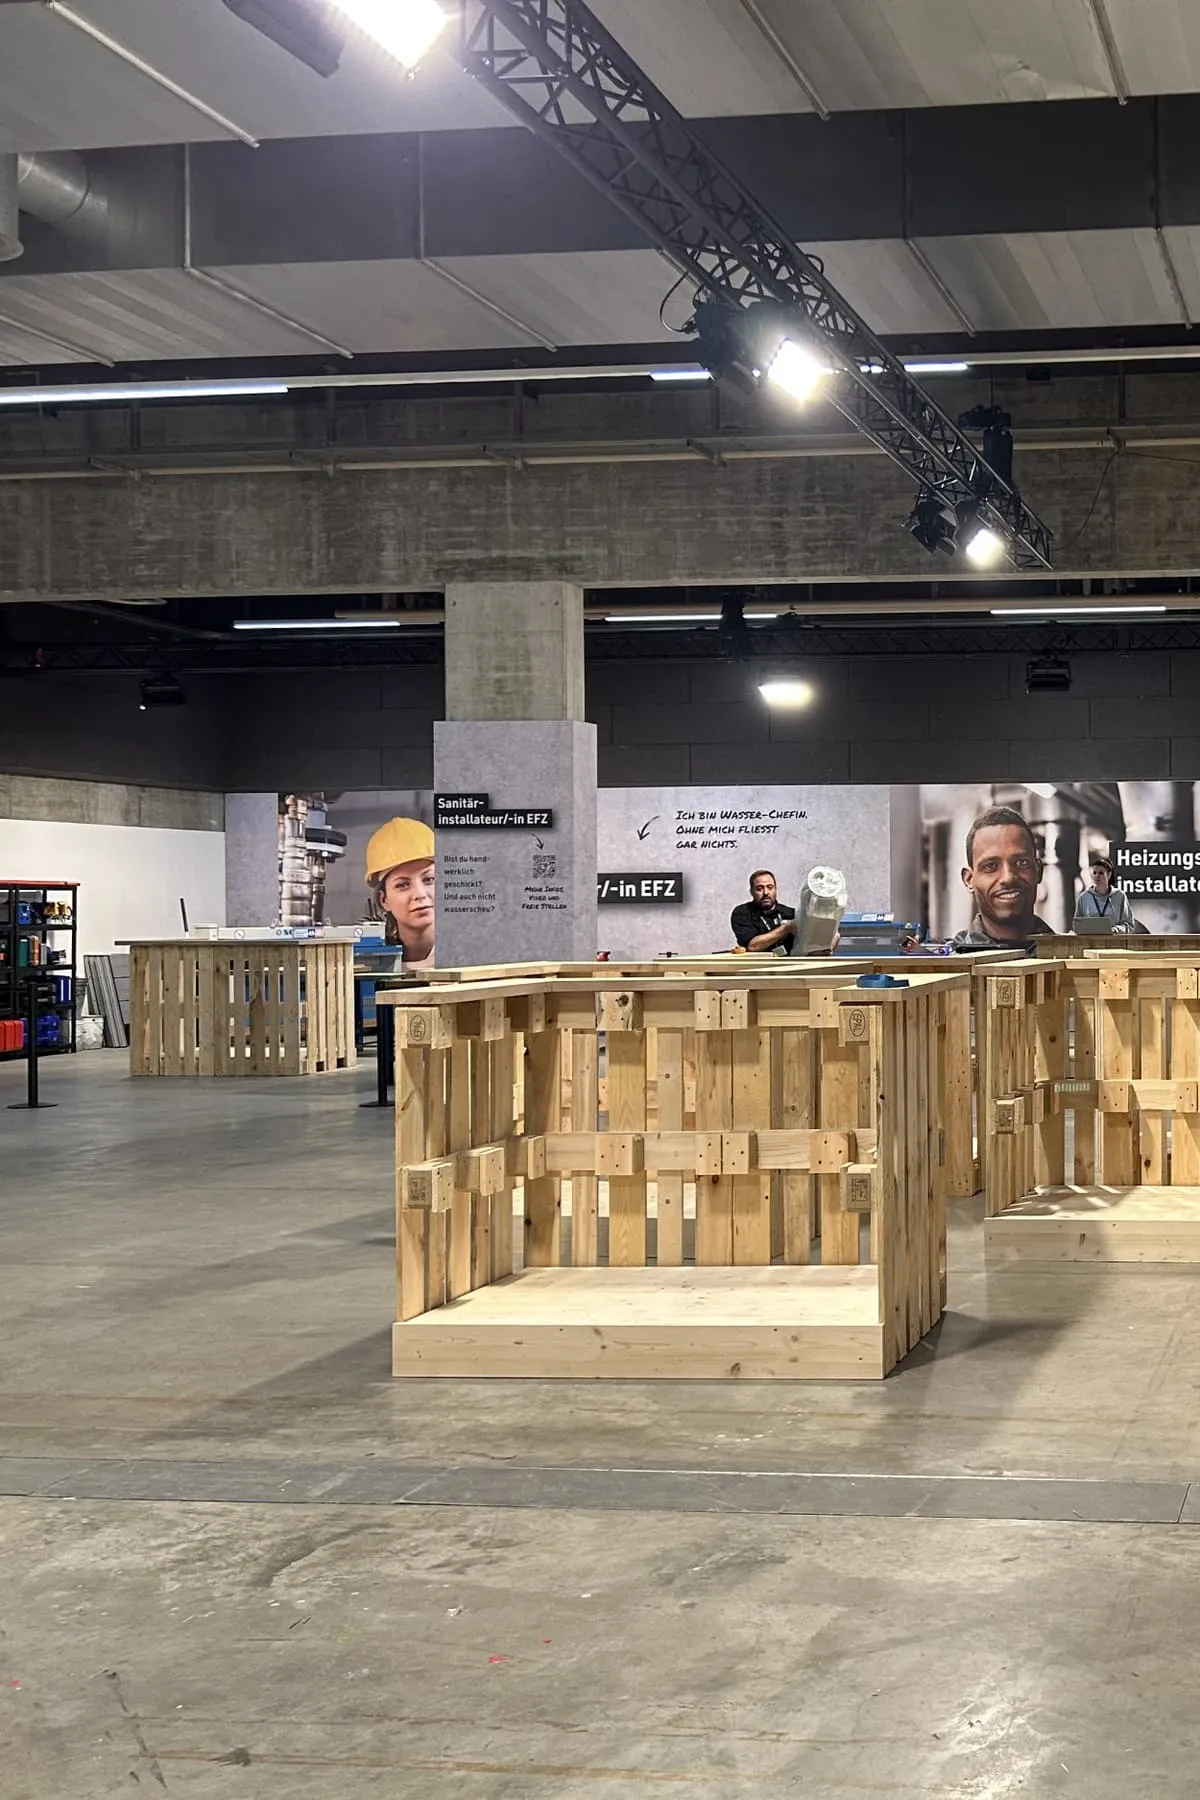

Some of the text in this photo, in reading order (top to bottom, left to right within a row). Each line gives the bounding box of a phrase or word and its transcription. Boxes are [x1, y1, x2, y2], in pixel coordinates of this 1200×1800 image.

[438, 798, 484, 809] Sanitär-
[438, 813, 549, 825] installateur/-in EFZ
[675, 809, 808, 820] ICH BIN WASSER-CHEFIN.
[675, 825, 779, 834] OHNE MICH FLIESST
[675, 840, 738, 848] GAR NICHTS.
[641, 879, 675, 897] EFZ
